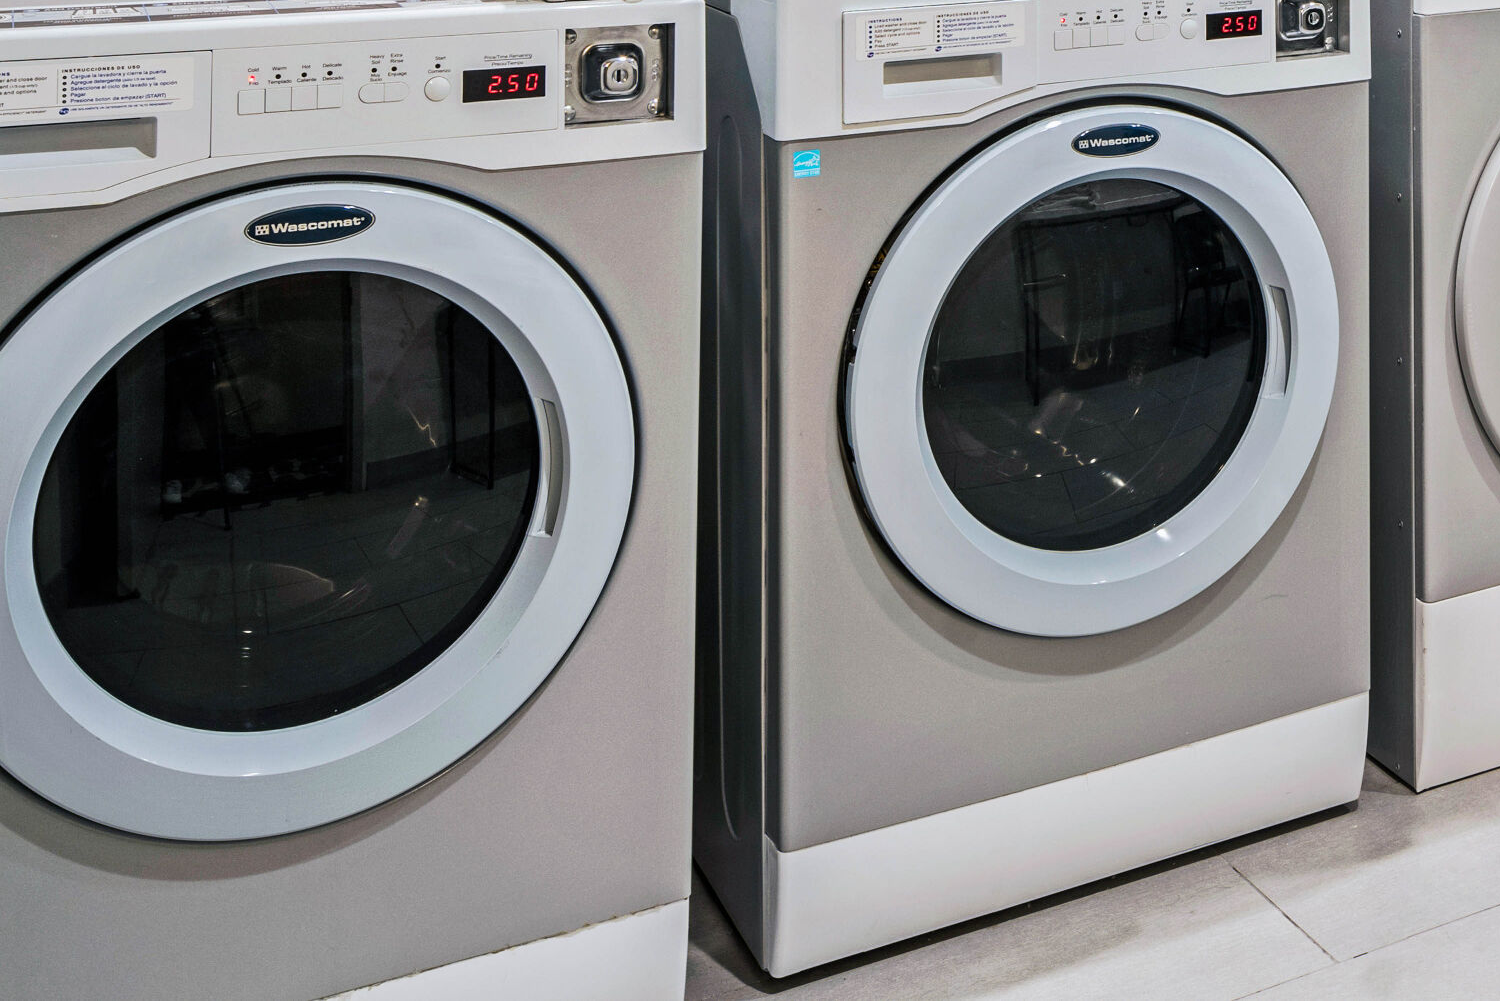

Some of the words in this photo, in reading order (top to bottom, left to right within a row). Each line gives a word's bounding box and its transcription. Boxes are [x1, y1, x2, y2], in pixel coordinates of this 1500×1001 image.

[1222, 15, 1257, 33] 2.50
[488, 73, 539, 94] 2.50
[1090, 134, 1152, 148] Wascomat
[270, 216, 362, 234] Wascomat
